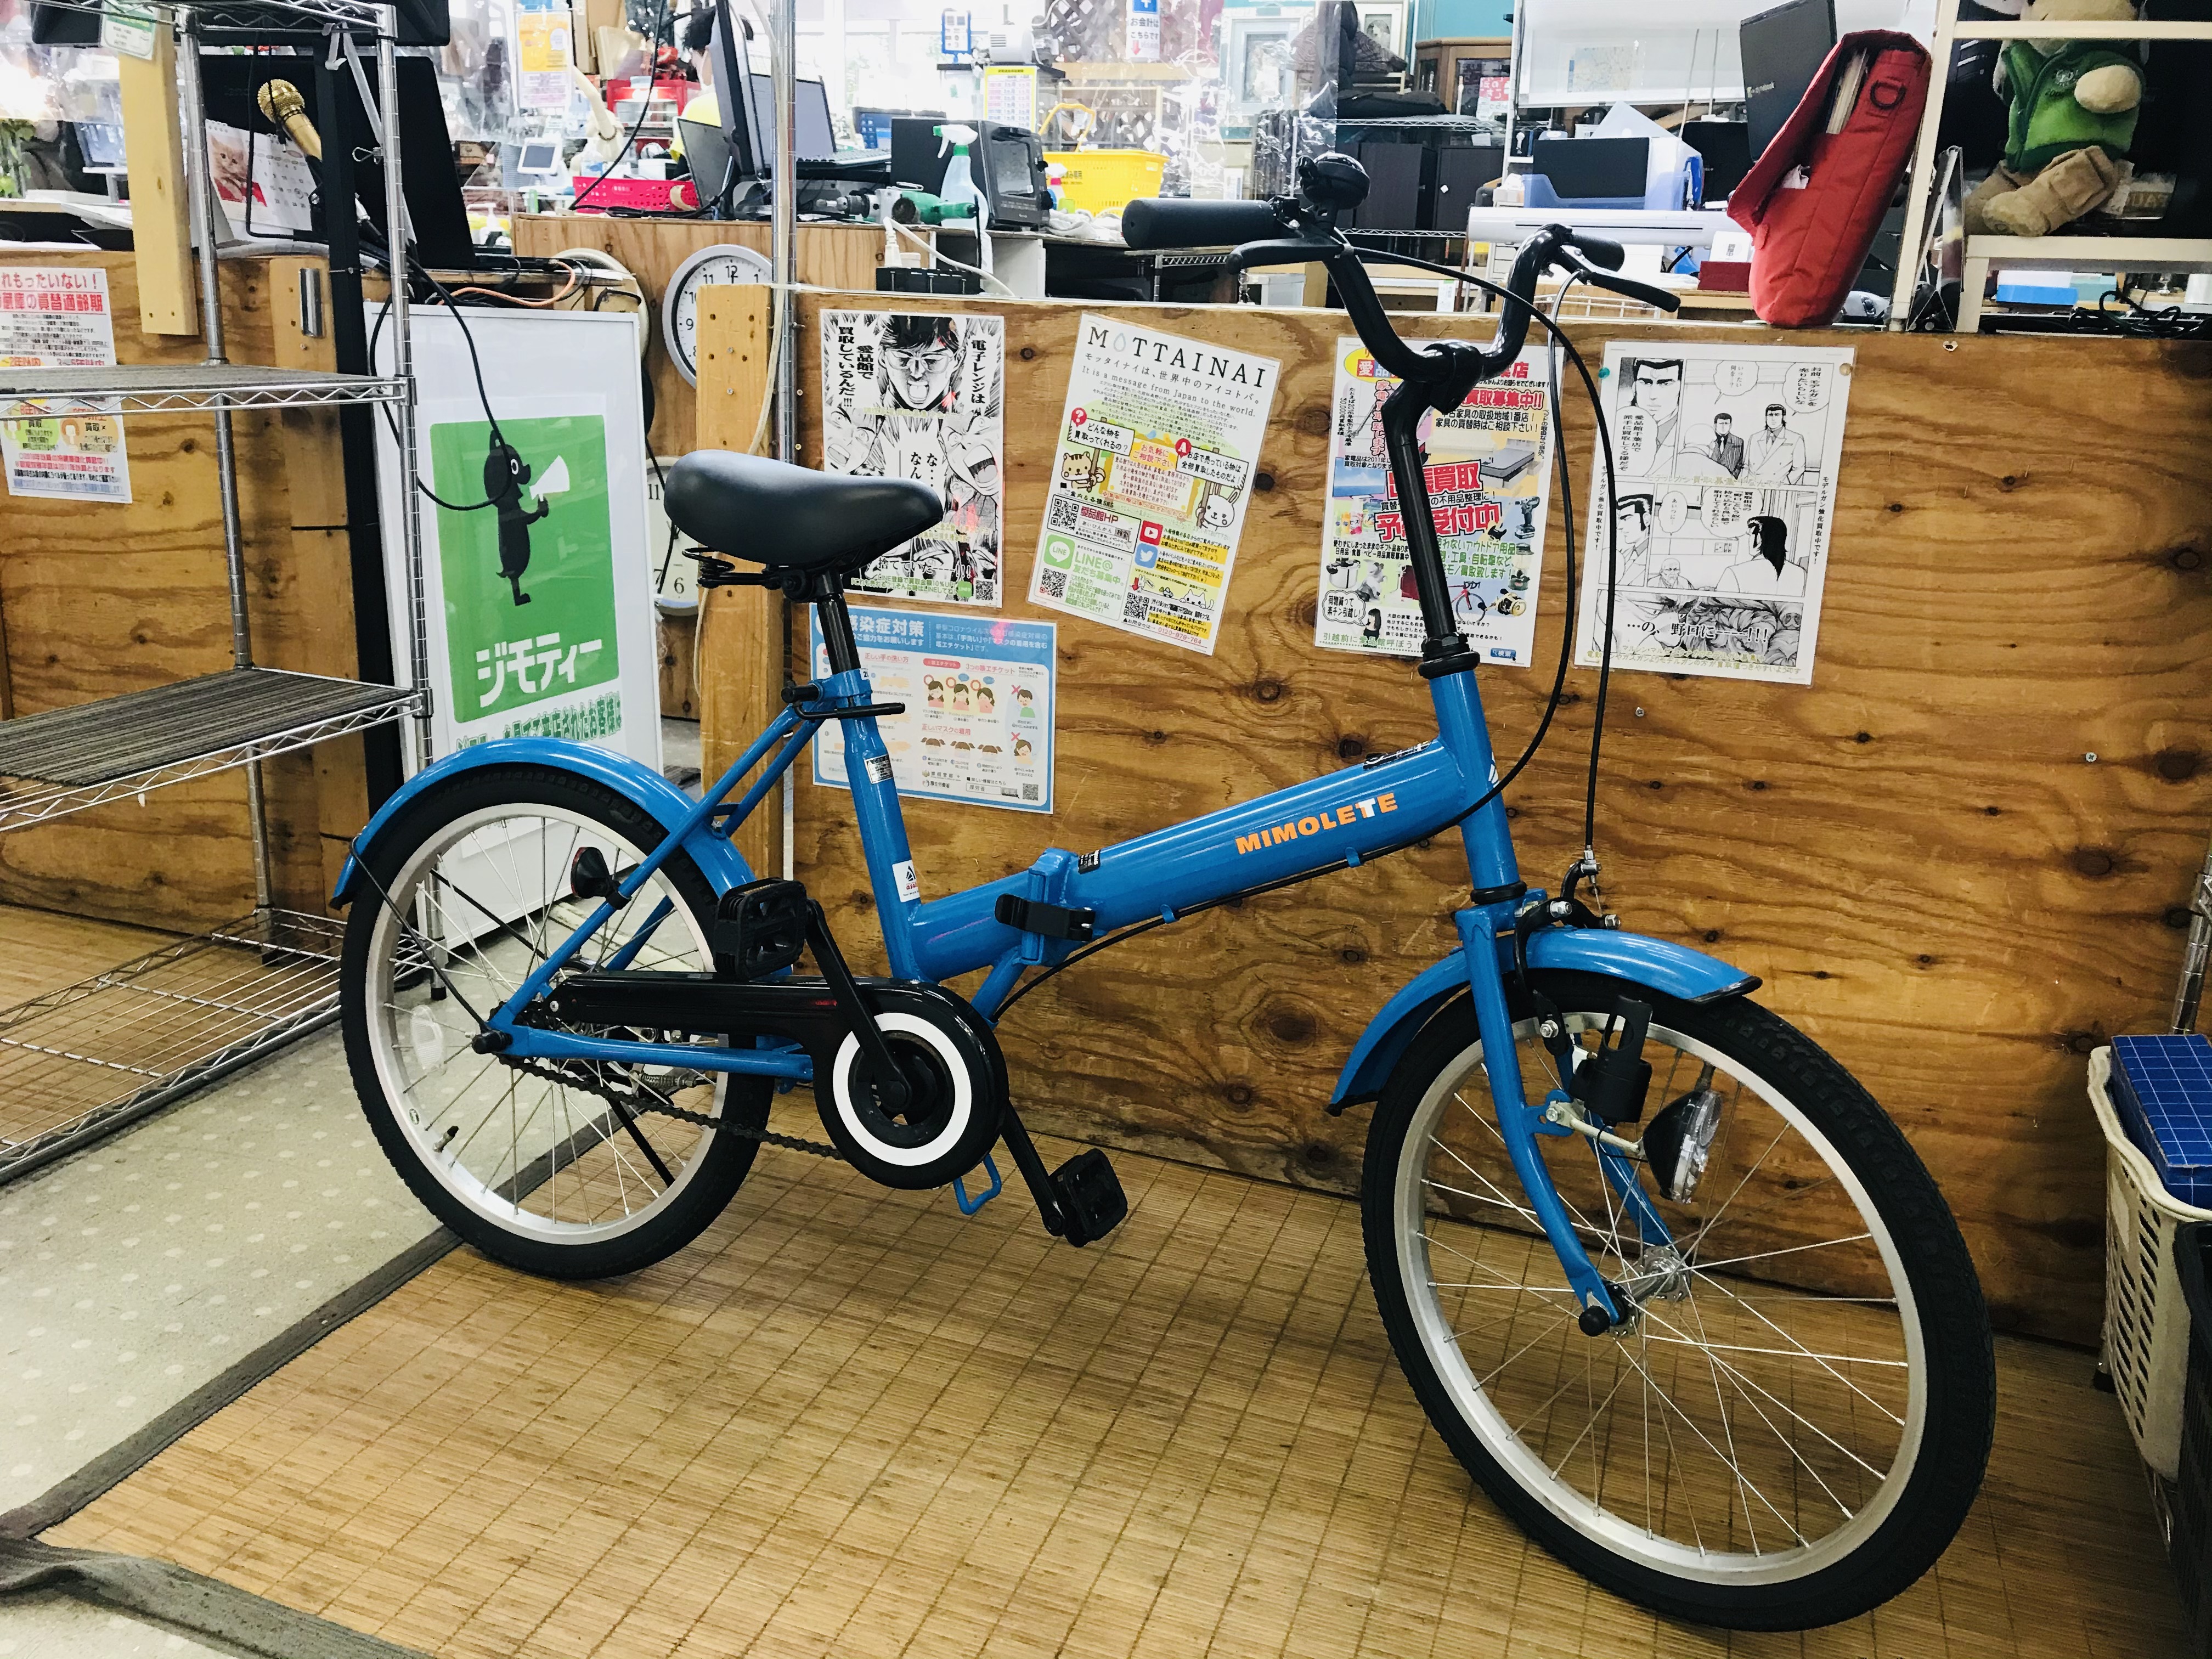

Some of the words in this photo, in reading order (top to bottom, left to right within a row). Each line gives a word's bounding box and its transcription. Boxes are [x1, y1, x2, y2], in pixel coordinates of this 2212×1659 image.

[1131, 31, 1159, 40] こちらです
[703, 274, 714, 284] 11
[725, 266, 738, 278] 12
[0, 292, 103, 312] 蔵庫の買替適齢期
[689, 292, 697, 304] 1
[686, 318, 694, 330] 9
[856, 345, 874, 380] 愛品館で
[1359, 360, 1398, 379] 愛品
[971, 340, 986, 404] 電子レンジは
[1082, 365, 1090, 374] It
[1092, 368, 1100, 377] is
[1111, 374, 1148, 389] message
[1150, 383, 1170, 395] from
[1173, 388, 1197, 402] Japan
[1201, 397, 1210, 405] to
[1212, 400, 1226, 409] the
[1230, 404, 1256, 417] world.
[1462, 390, 1543, 409] 買取募集中!!
[1087, 423, 1120, 439] どんな物を
[1435, 417, 1537, 432] 家具の買替時はご相談下さい！
[1074, 430, 1128, 453] 買取ってくれるの？
[1178, 442, 1187, 454] A
[1133, 450, 1173, 468] ご相談下さい
[1141, 444, 1169, 458] お気軽に
[1187, 452, 1242, 473] お店で売っている物は
[1181, 461, 1240, 484] 全部買取したものだよ！
[1381, 501, 1400, 511] 買替
[1430, 490, 1496, 506] の不用品整理に！
[1080, 506, 1119, 524] 愛品館HP
[1377, 503, 1500, 541] 予受付中
[1813, 476, 1829, 565] モデルガン強化買取中です！
[1052, 546, 1067, 556] LINE
[1075, 551, 1113, 572] LINE@
[653, 568, 663, 584] 7
[1073, 563, 1124, 586] 友だち募集中。
[674, 577, 685, 594] 6
[1328, 595, 1355, 607] 荷物減って
[1327, 606, 1361, 619] 楽チン引越し！
[1323, 632, 1420, 650] 引越前に愛品館呼ぼう！
[865, 652, 909, 663] 正しい手の洗い方
[476, 632, 602, 708] ジモティー
[966, 663, 1015, 674] 3つの咳エチケット
[922, 723, 972, 736] 正しいマスクの着用
[1234, 792, 1398, 856] MIMOLETE
